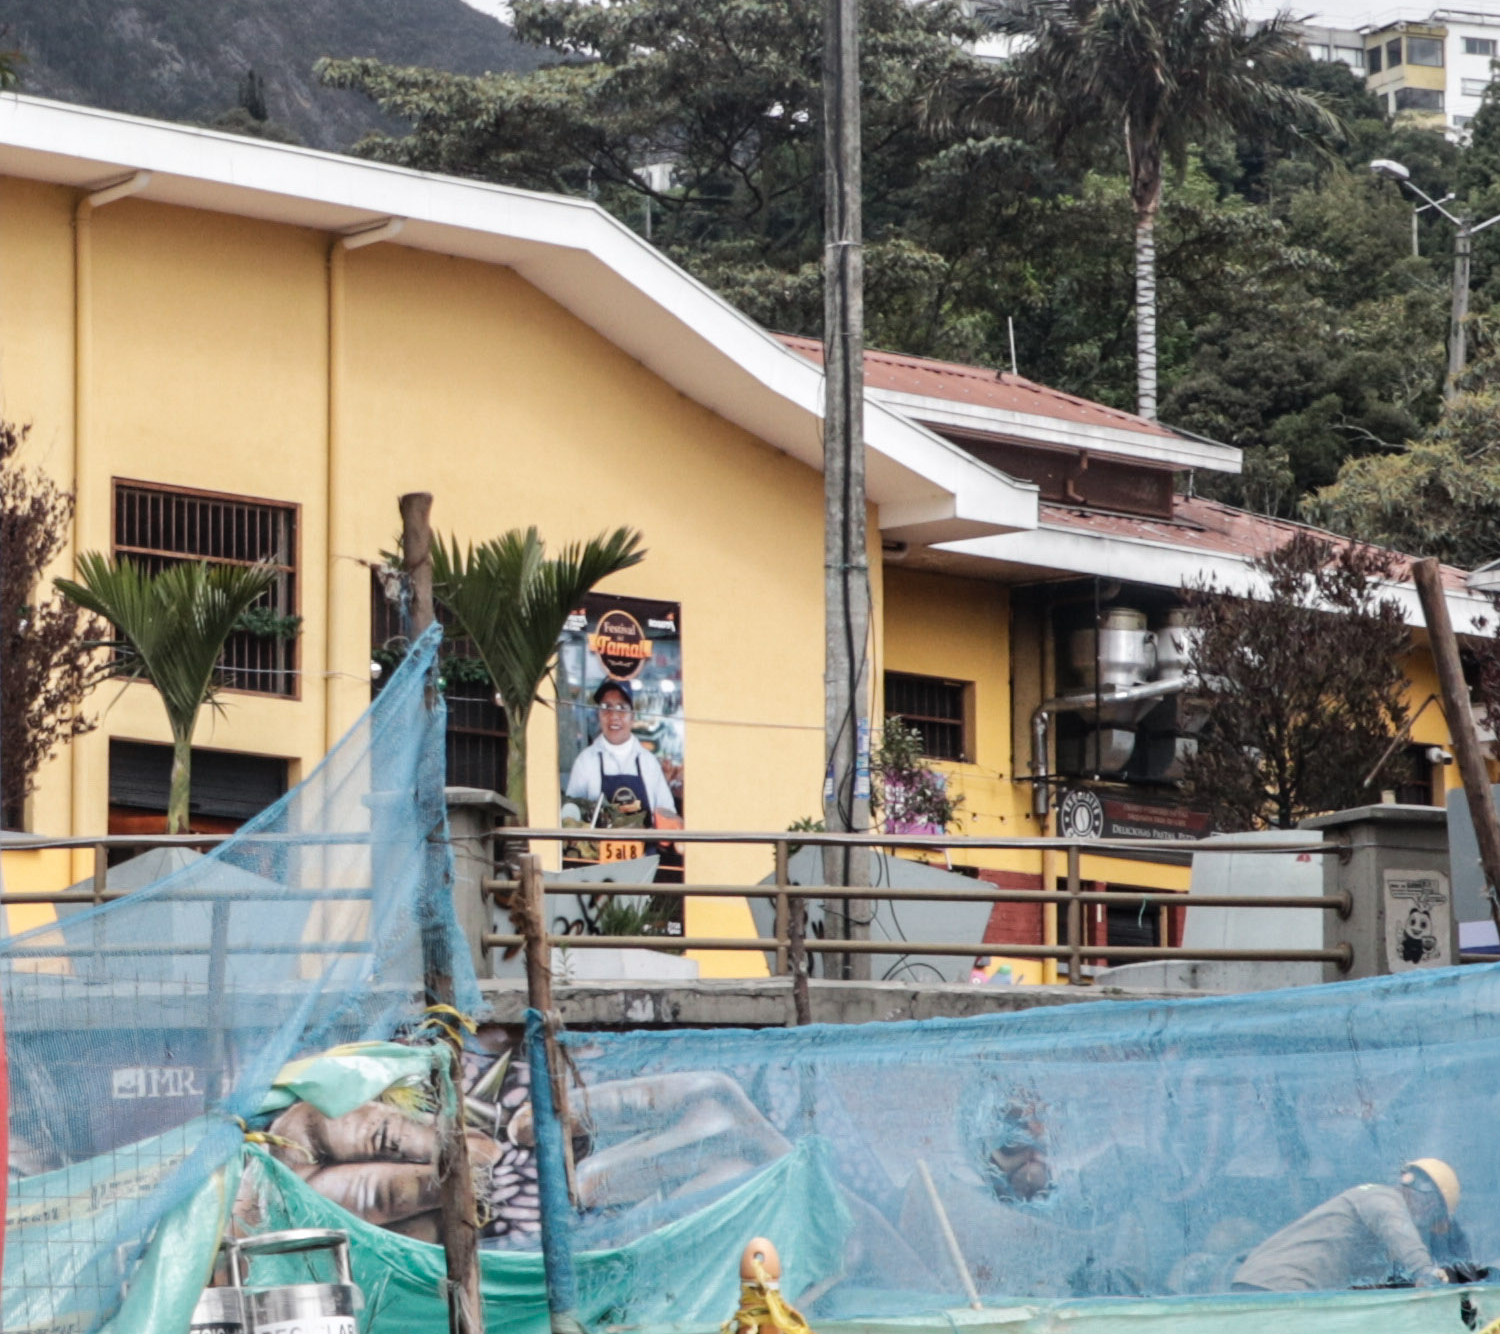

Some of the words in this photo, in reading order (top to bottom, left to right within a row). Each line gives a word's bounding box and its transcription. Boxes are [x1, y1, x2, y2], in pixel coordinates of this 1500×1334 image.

[604, 621, 636, 635] Festival
[596, 635, 646, 659] Tamal
[606, 843, 612, 859] 5
[615, 845, 626, 860] al
[630, 845, 637, 859] 8
